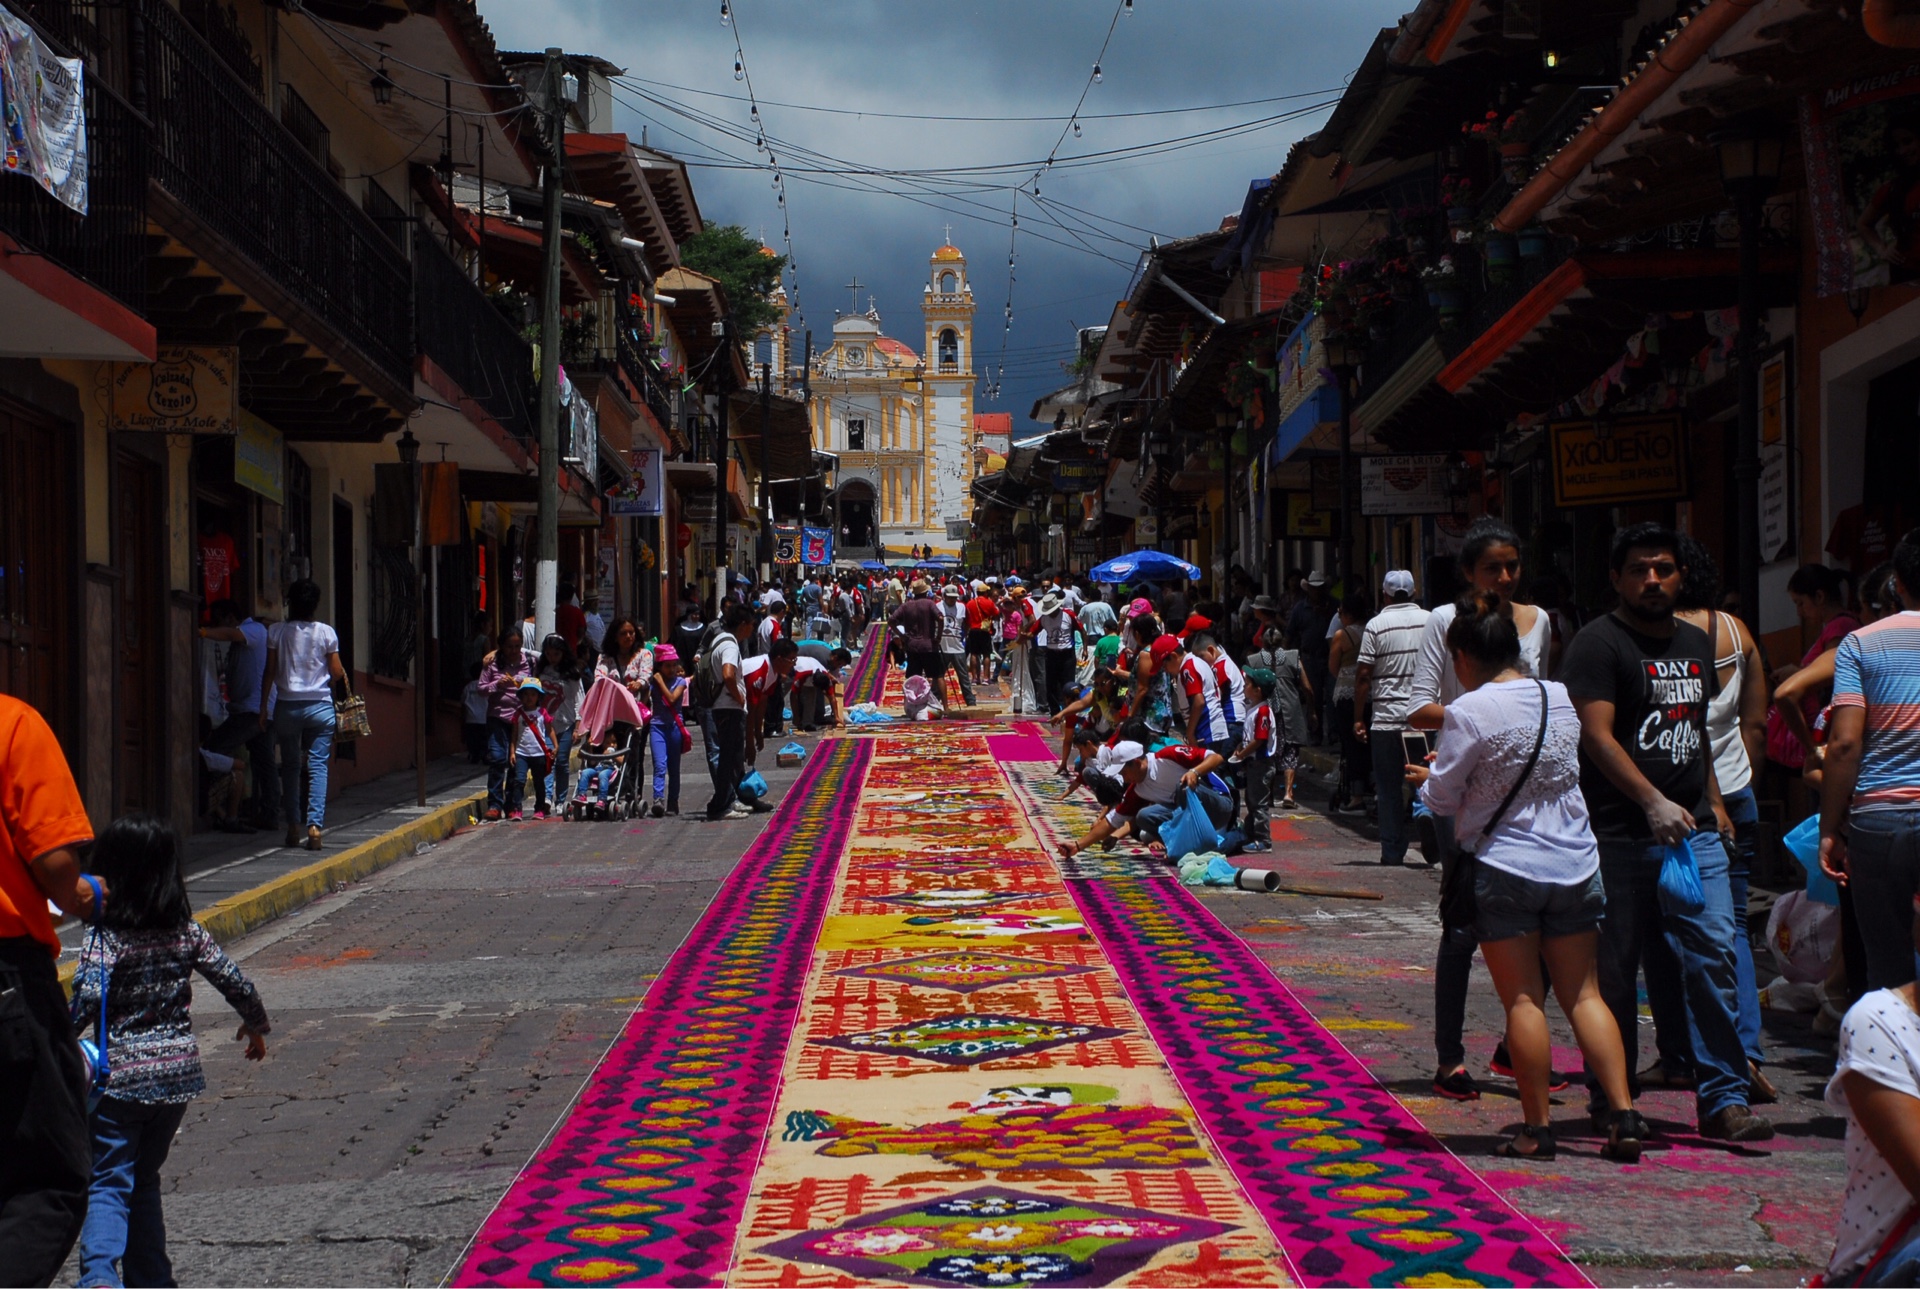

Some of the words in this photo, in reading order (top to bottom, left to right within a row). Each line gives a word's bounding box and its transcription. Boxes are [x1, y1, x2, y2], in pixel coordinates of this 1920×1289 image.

[1853, 70, 1902, 95] VIENE
[116, 365, 133, 388] Para
[187, 349, 208, 367] Buen
[208, 365, 228, 387] sabor
[154, 370, 190, 388] Calzada
[168, 385, 177, 394] de
[130, 412, 167, 426] Licores
[182, 415, 217, 428] Mole
[1370, 457, 1394, 466] MOLE
[1565, 471, 1598, 485] MOLE
[1620, 469, 1636, 481] EN
[1637, 465, 1674, 481] PASTA
[776, 537, 795, 561] 5
[808, 538, 826, 563] 5
[1654, 661, 1690, 678] DAY
[1649, 678, 1703, 705] BEGINS
